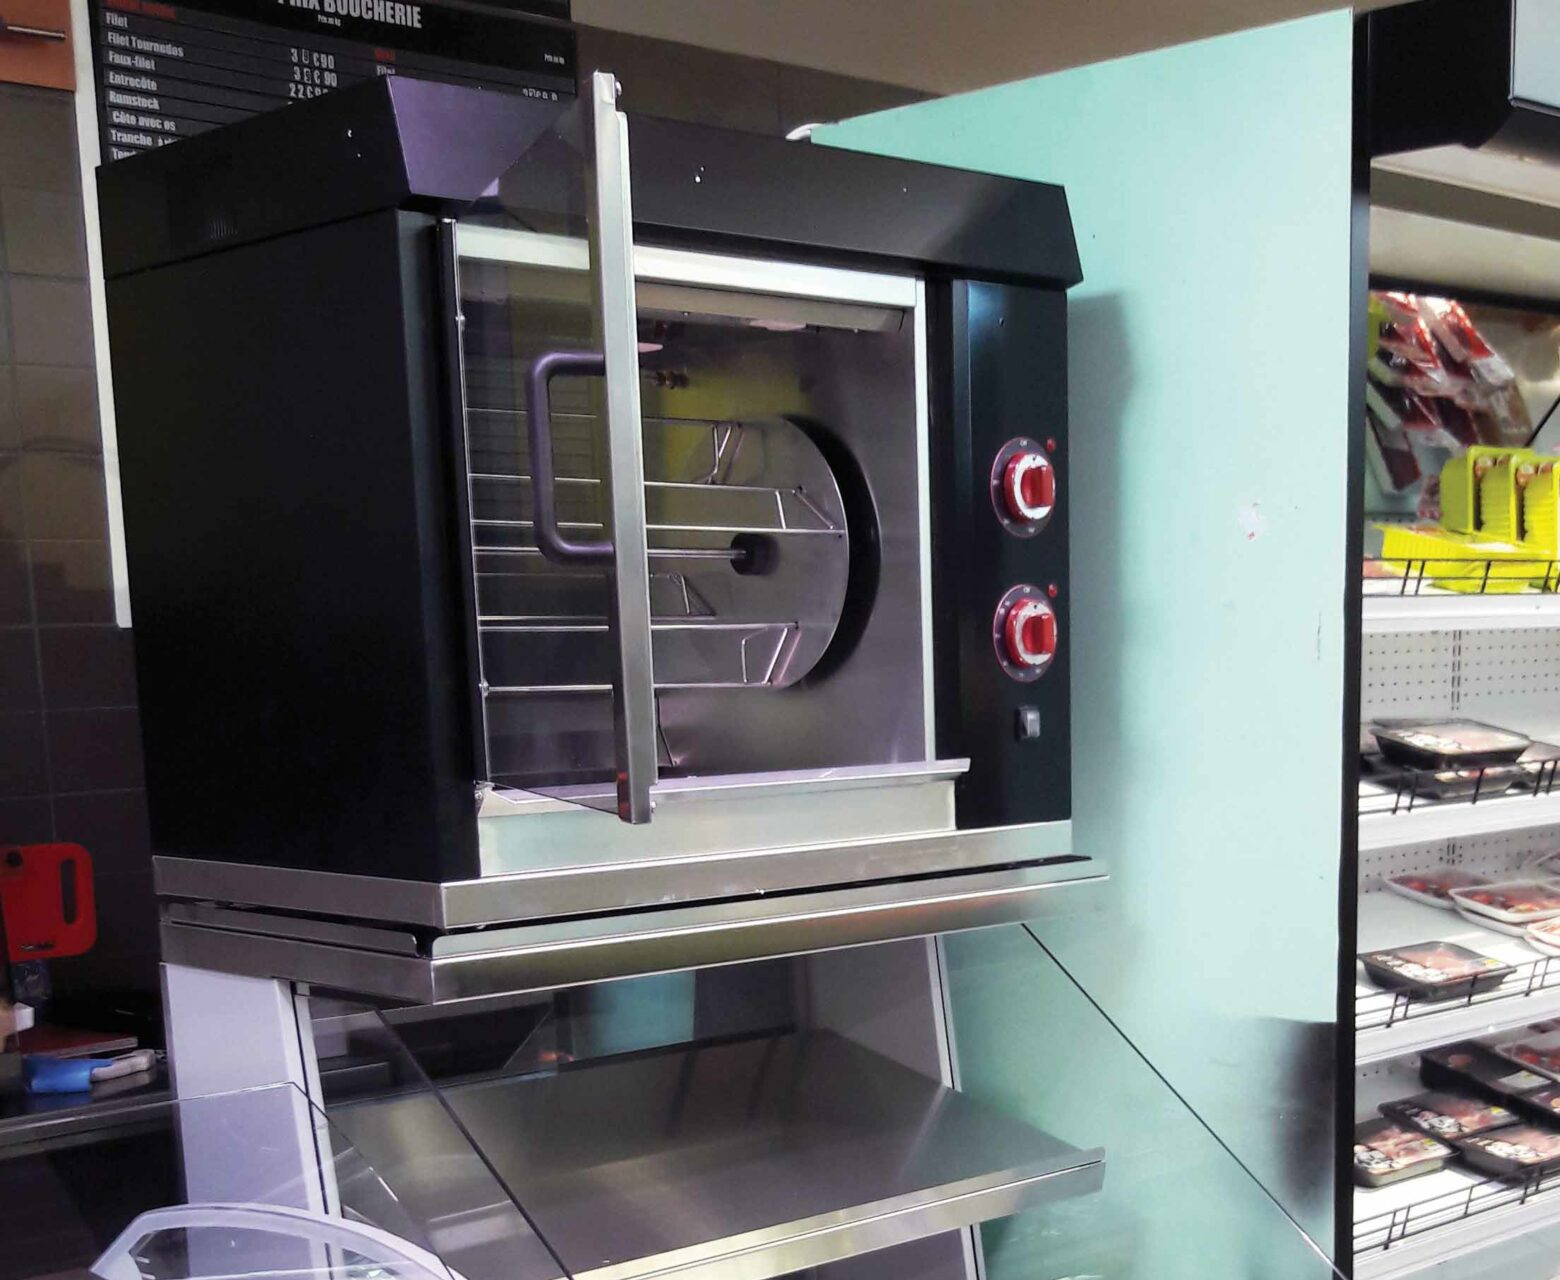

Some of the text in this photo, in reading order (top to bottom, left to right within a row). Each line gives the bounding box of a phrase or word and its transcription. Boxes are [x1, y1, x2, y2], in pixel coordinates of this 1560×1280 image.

[106, 12, 128, 28] Filet
[324, 0, 422, 28] BOUCHERIE
[108, 31, 184, 57] Filet Tournedos
[109, 50, 156, 70] Faux-filet
[109, 71, 158, 91] Entrecôte
[110, 129, 153, 146] Tranche
